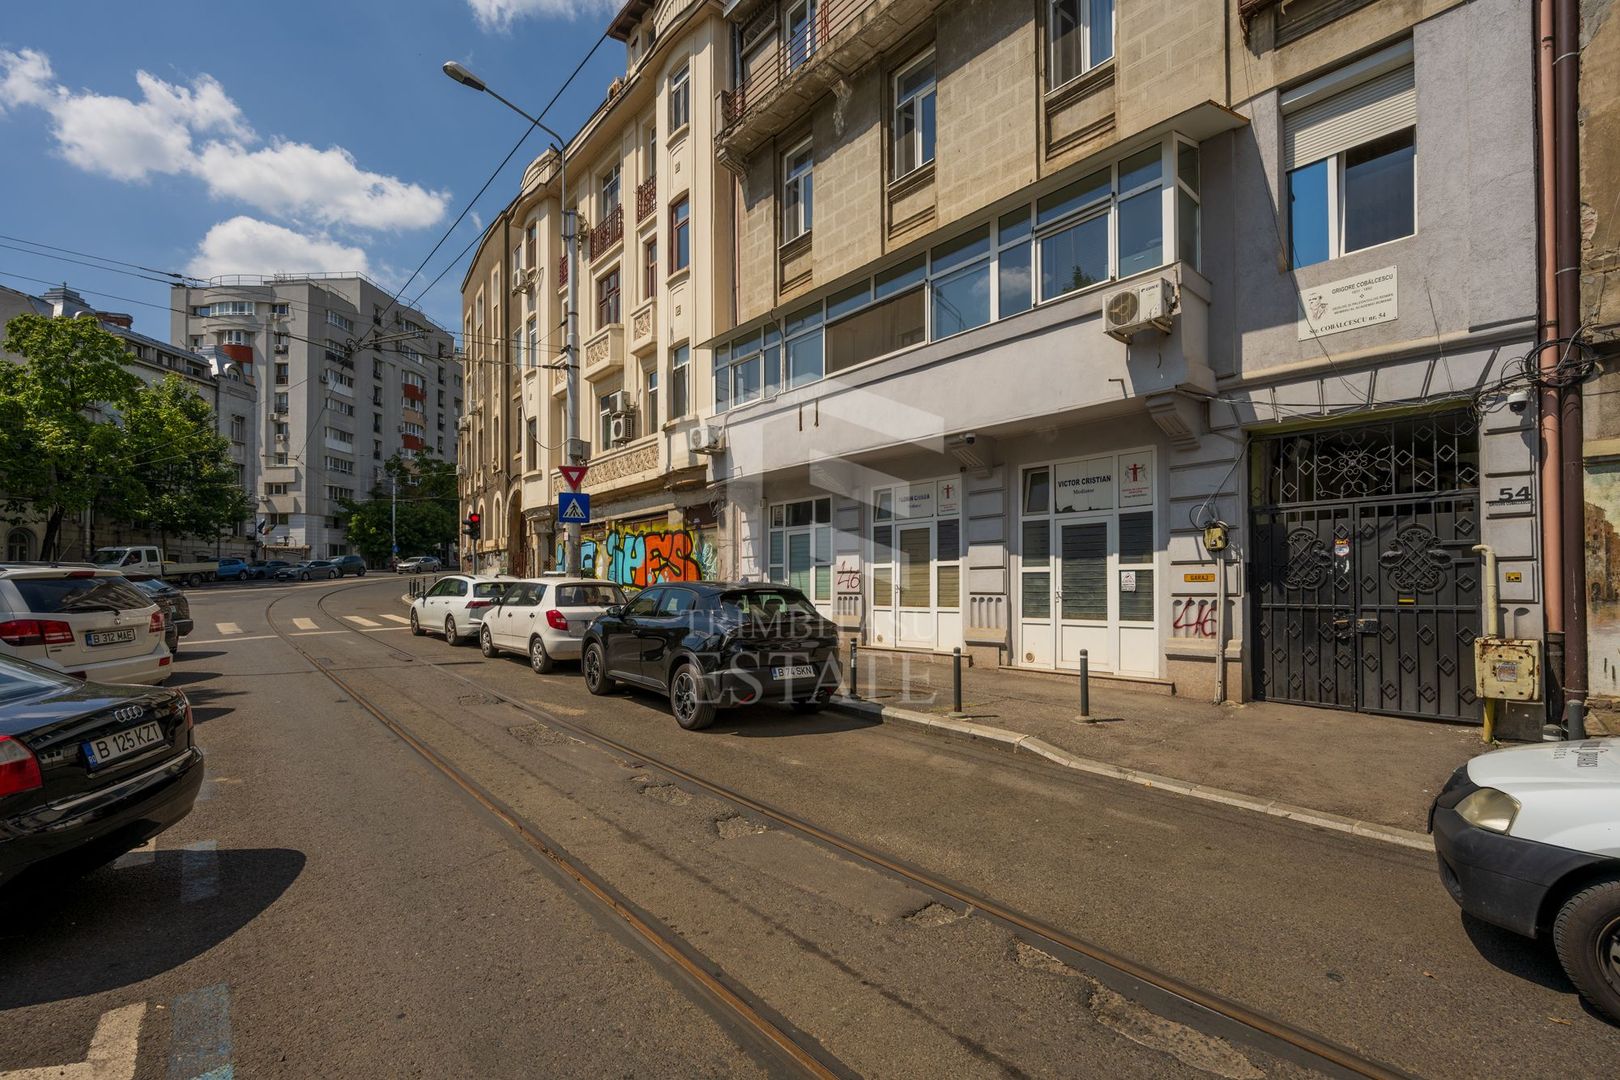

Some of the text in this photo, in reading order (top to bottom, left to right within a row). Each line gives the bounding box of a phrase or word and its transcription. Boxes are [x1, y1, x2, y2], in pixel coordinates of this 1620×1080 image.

[1331, 284, 1355, 294] GRIGORE
[1057, 475, 1112, 488] VICTOR CRISTIAN
[1498, 486, 1532, 502] 54
[93, 630, 133, 644] B 312 MAE
[778, 668, 785, 677] B
[796, 666, 812, 676] SKN
[96, 723, 160, 760] B 125 KZT
